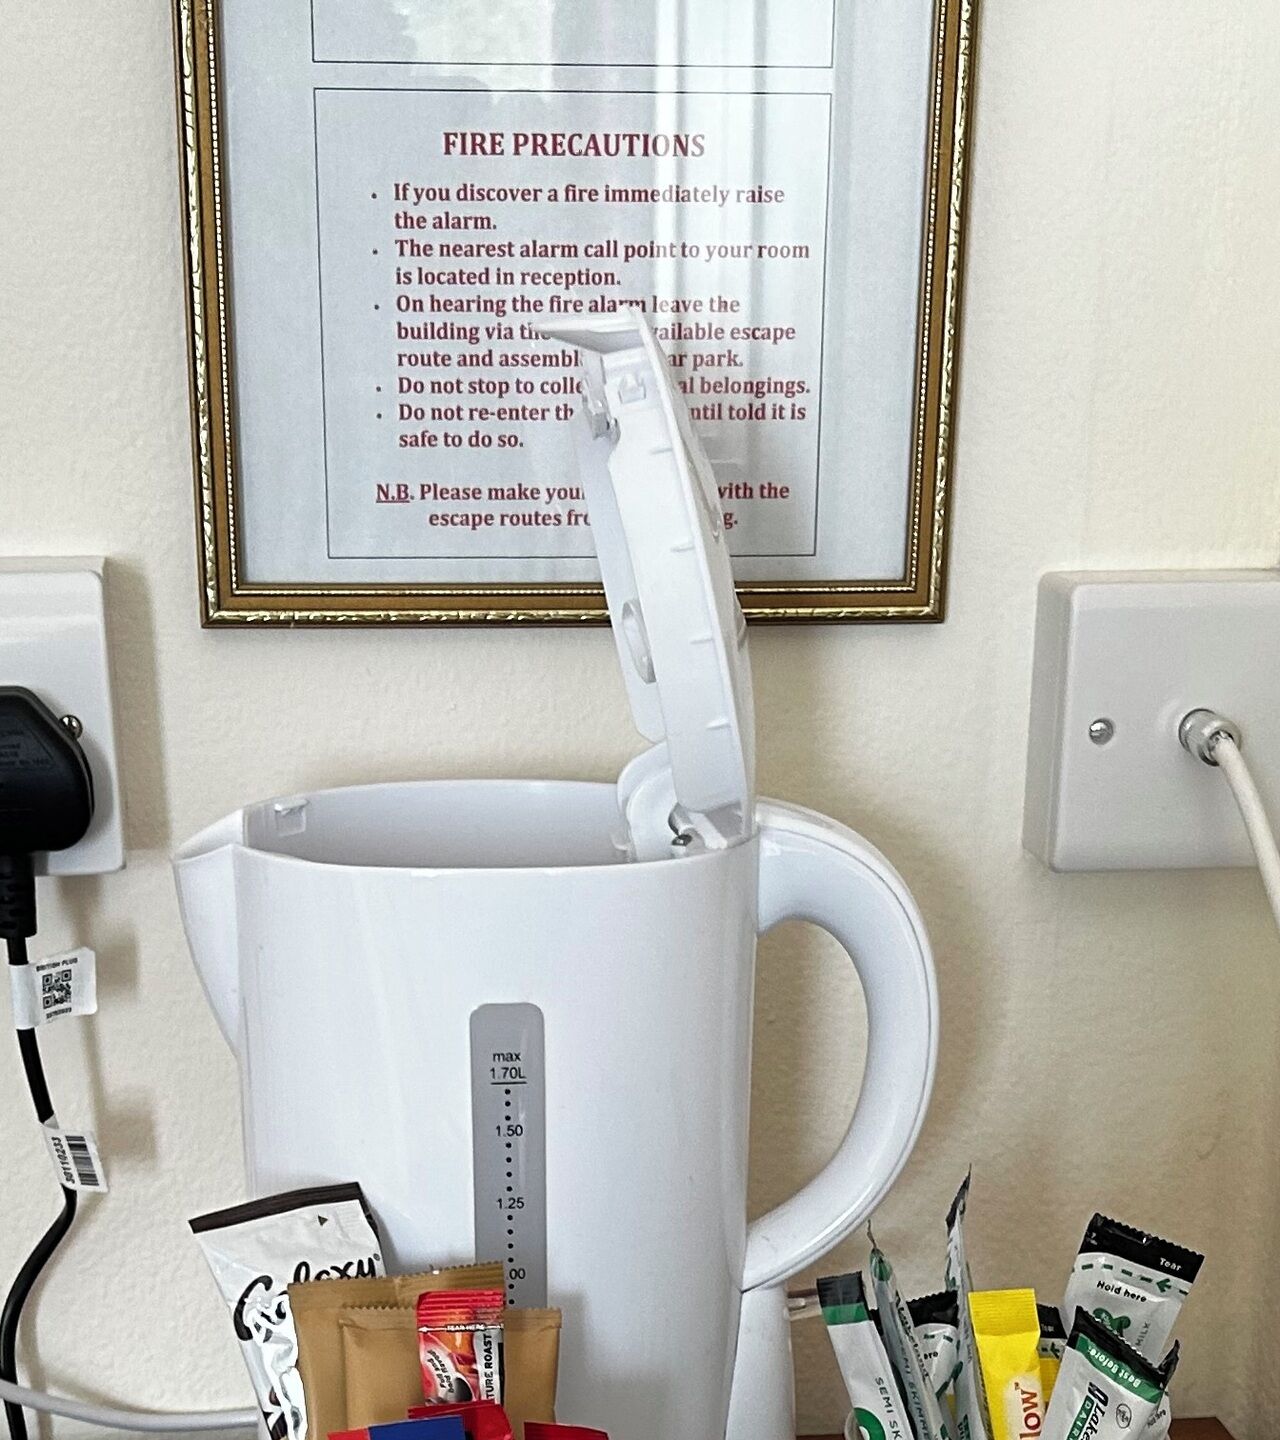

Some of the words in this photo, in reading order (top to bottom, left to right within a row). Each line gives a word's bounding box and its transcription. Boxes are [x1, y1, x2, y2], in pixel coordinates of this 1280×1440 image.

[443, 132, 505, 156] FIRE
[513, 133, 705, 157] PRECAUTIONS
[394, 182, 410, 202] If
[413, 187, 451, 206] you
[456, 183, 543, 203] discover
[547, 187, 559, 202] a
[564, 184, 599, 203] fire
[605, 184, 730, 207] immediately
[736, 185, 785, 203] raise
[394, 211, 427, 230] the
[432, 211, 497, 230] alarm.
[394, 238, 434, 258] The
[438, 241, 515, 258] nearest
[519, 239, 579, 258] alarm
[584, 240, 619, 258] call
[623, 240, 677, 263] point
[681, 241, 700, 259] to
[704, 244, 753, 263] your
[756, 244, 810, 259] room
[395, 266, 412, 286] is
[417, 266, 490, 286] located
[496, 267, 515, 286] in
[520, 267, 622, 290] reception.
[396, 294, 425, 313] On
[429, 294, 507, 318] hearing
[511, 294, 544, 313] the
[548, 295, 584, 313] fire
[652, 295, 704, 313] leave
[709, 295, 740, 313] the
[396, 321, 480, 345] building
[484, 322, 515, 340] via
[730, 325, 797, 345] escape
[397, 352, 452, 368] route
[456, 349, 494, 368] and
[498, 349, 583, 368] assembl
[668, 353, 688, 368] ar
[692, 349, 744, 371] park.
[397, 376, 424, 395] Do
[429, 378, 464, 395] not
[468, 378, 510, 399] stop
[515, 378, 535, 395] to
[700, 376, 811, 399] belongings.
[398, 403, 425, 421] Do
[430, 404, 464, 421] not
[468, 404, 550, 421] re-enter
[728, 403, 767, 421] told
[771, 403, 785, 421] it
[790, 403, 807, 421] is
[398, 429, 438, 448] safe
[443, 431, 463, 448] to
[467, 430, 493, 448] do
[497, 433, 524, 448] so.
[375, 483, 415, 504] N.B.
[419, 483, 482, 501] Please
[487, 483, 541, 501] make
[759, 482, 790, 500] the
[428, 511, 495, 531] escape
[499, 511, 562, 527] routes
[492, 1051, 521, 1063] max
[489, 1066, 527, 1080] 1.70L
[495, 1124, 524, 1137] 1.50
[496, 1197, 525, 1210] 1.25
[505, 1267, 526, 1280] .00
[1159, 1257, 1182, 1272] Tear
[1096, 1280, 1122, 1295] Hold
[1123, 1289, 1147, 1303] here
[483, 1333, 493, 1370] ROAST
[1118, 1369, 1142, 1388] Best
[875, 1376, 893, 1414] SEMI
